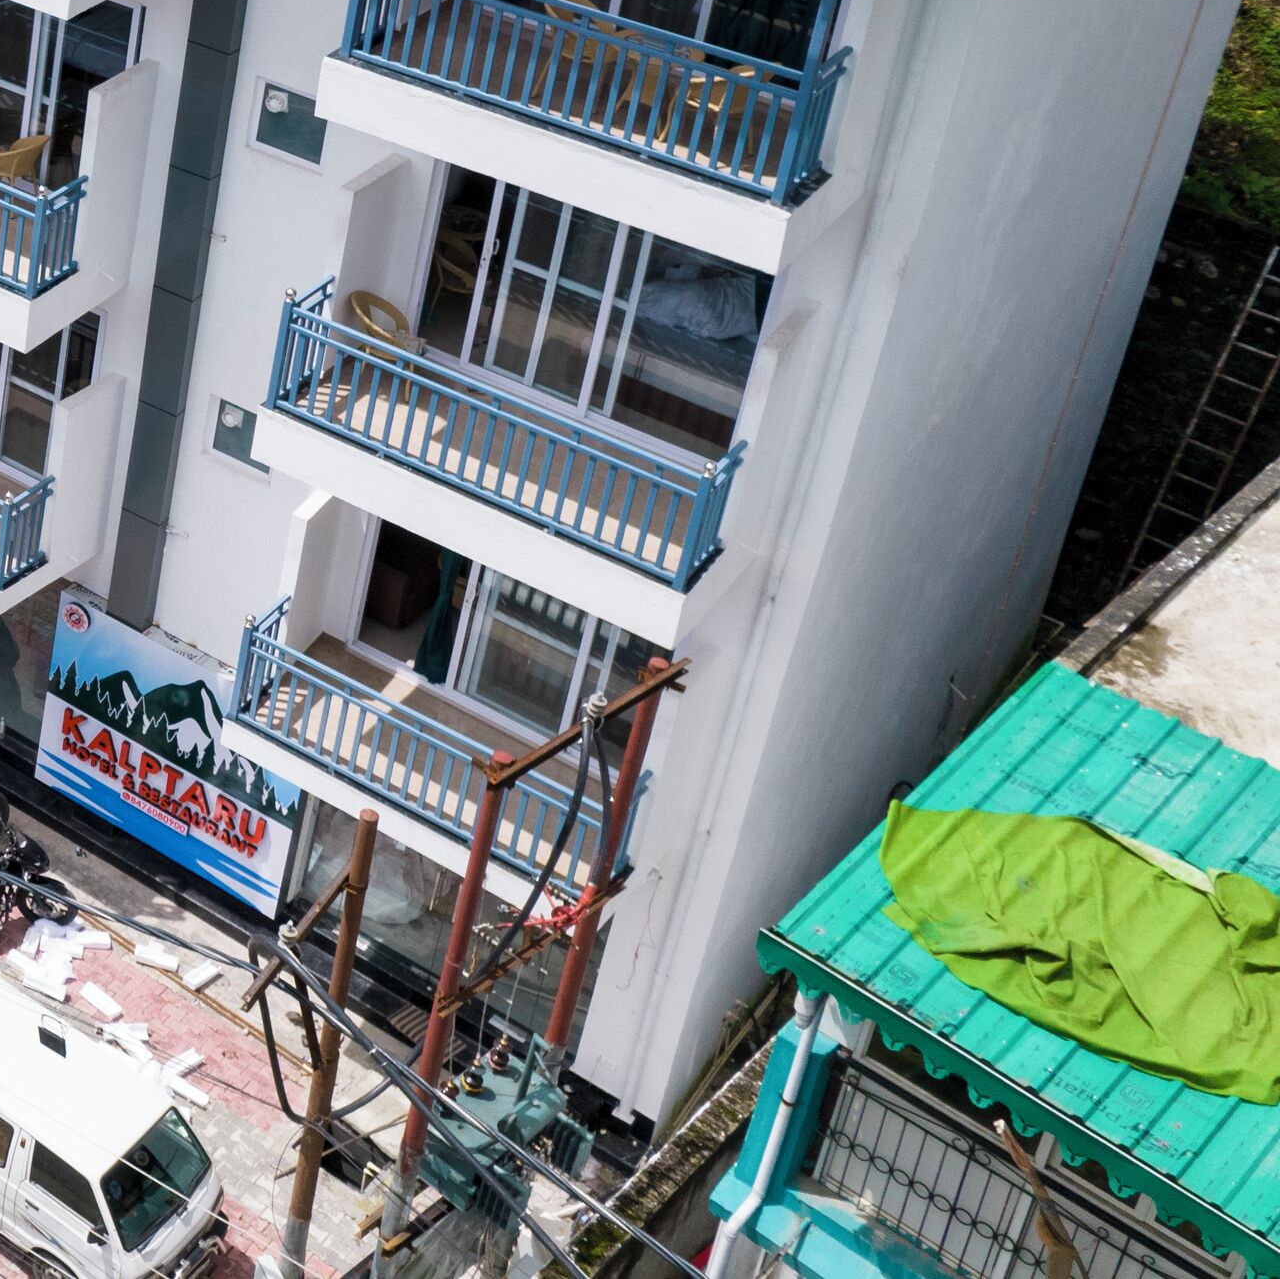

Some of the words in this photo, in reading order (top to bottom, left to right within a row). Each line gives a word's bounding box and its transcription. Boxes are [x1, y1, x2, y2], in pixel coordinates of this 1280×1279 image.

[61, 707, 269, 846] KALPTARU
[62, 737, 119, 781] HOTEL
[122, 773, 136, 792] &
[138, 782, 260, 860] RESTAURANT
